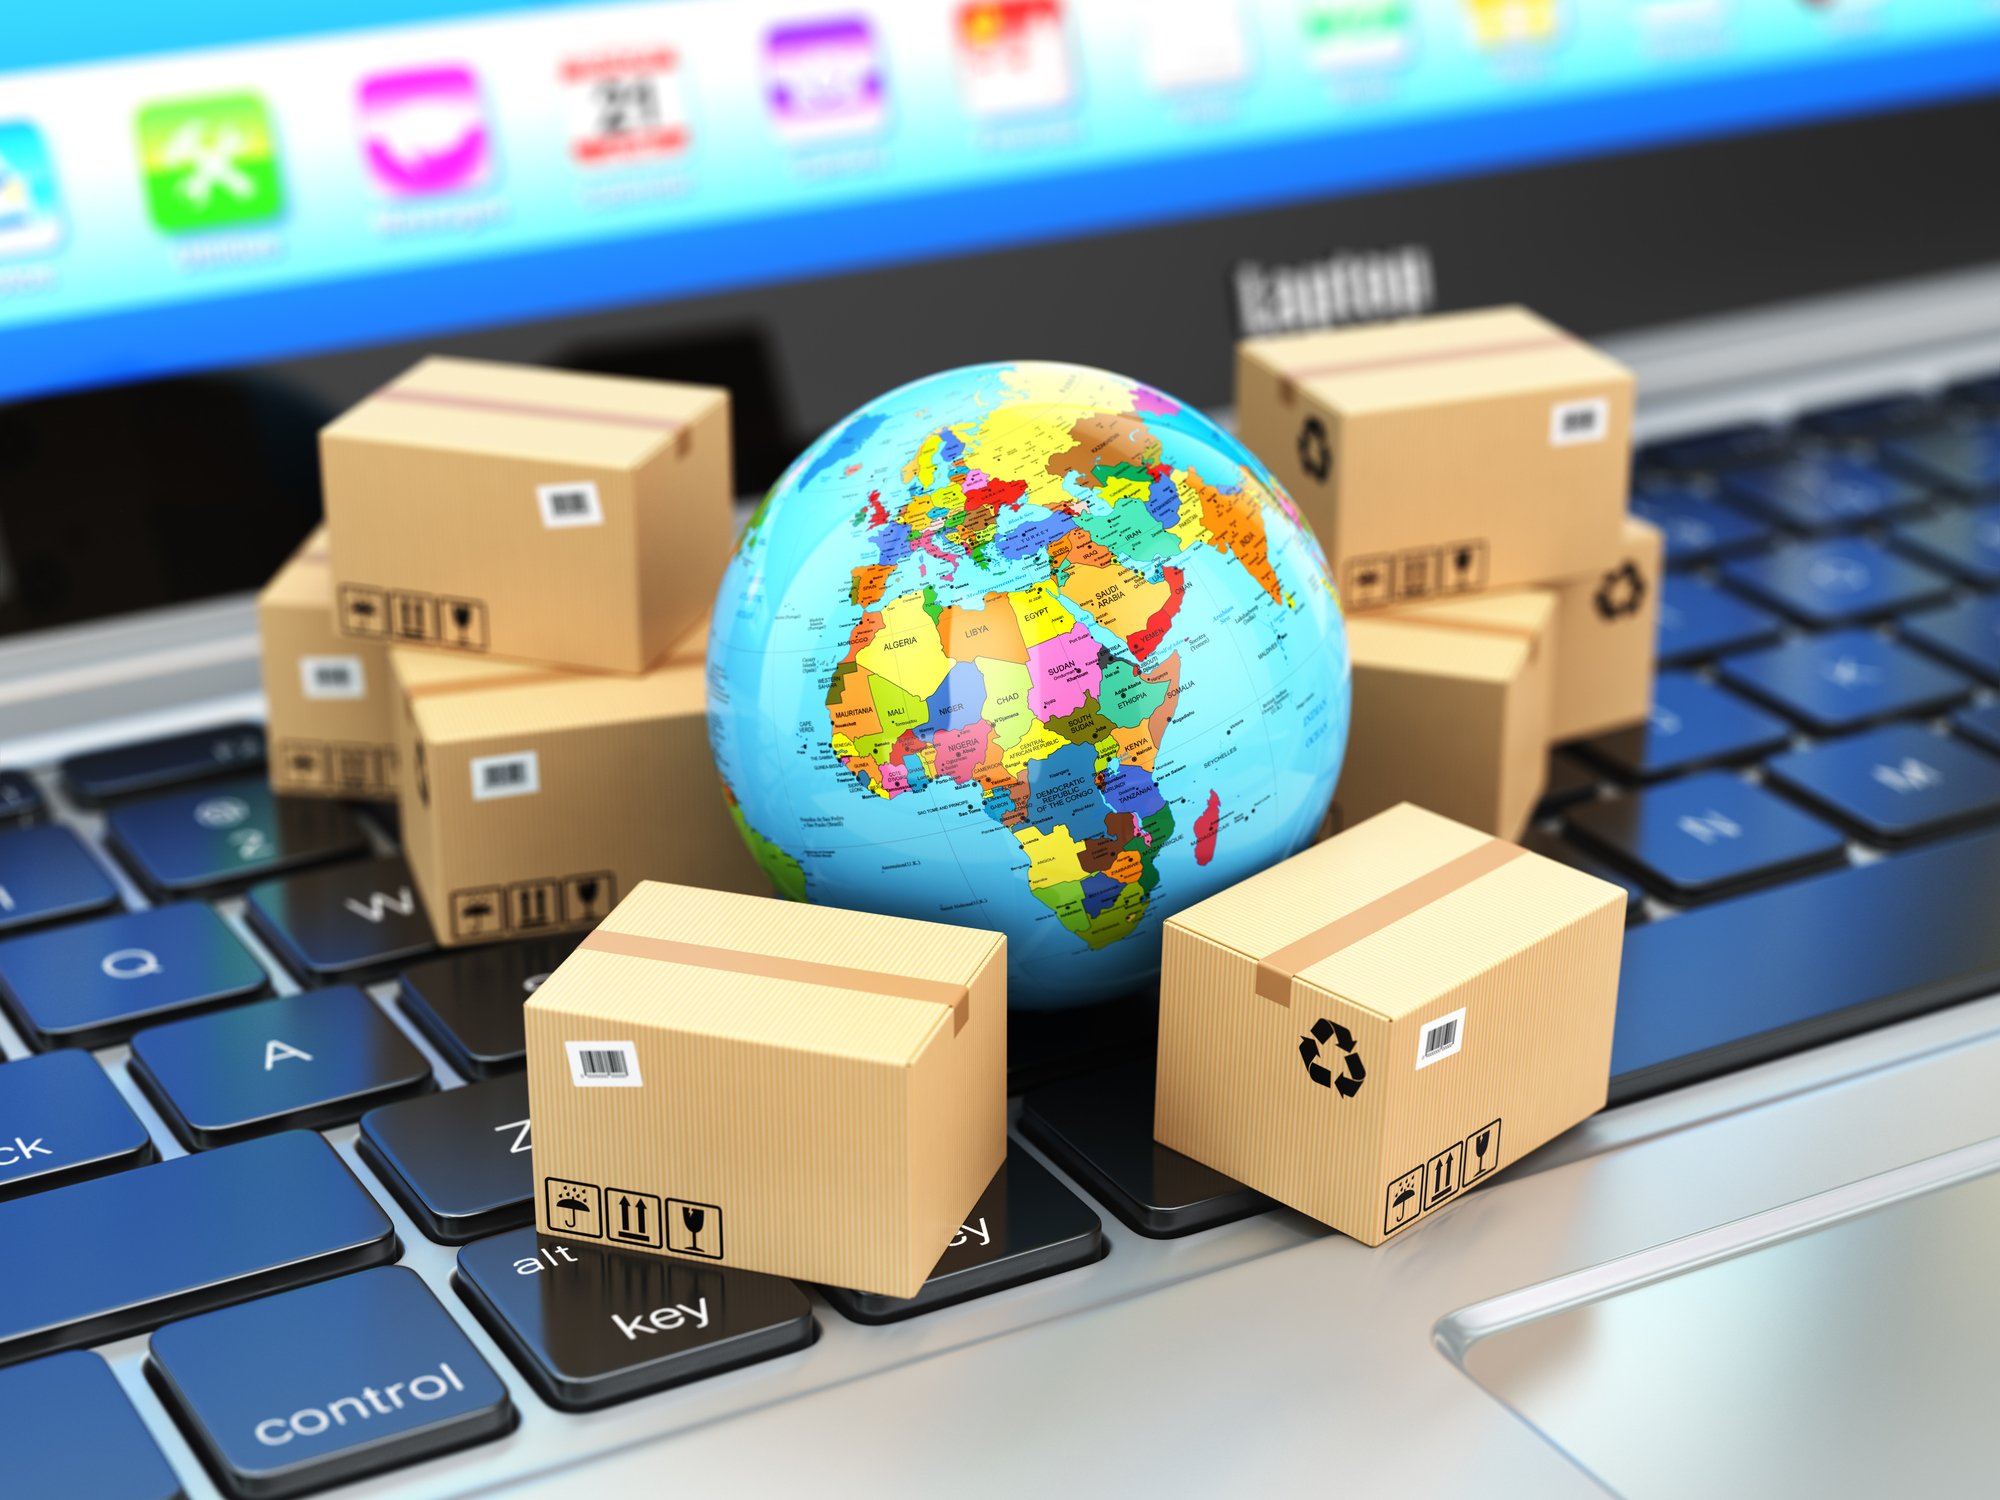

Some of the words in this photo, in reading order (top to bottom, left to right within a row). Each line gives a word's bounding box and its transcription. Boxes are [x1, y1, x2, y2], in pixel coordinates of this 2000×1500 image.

[1179, 514, 1198, 529] PAKISTAN
[1125, 529, 1142, 541] IRAN
[1083, 550, 1098, 560] IRAQ
[966, 579, 1014, 598] Mediterranean
[1096, 585, 1119, 600] SAUDI
[1175, 582, 1192, 594] OMAN
[1098, 591, 1125, 608] ARABIA
[1024, 607, 1049, 622] EGYPT
[965, 625, 989, 638] LIBYA
[1140, 627, 1164, 643] YEMEN
[838, 637, 868, 647] MOROCCO
[884, 637, 917, 651] ALGERIA
[1190, 637, 1209, 652] (Yemen)
[1048, 660, 1075, 676] SUDAN
[1114, 687, 1127, 696] Addis
[1167, 681, 1195, 698] SOMALIA
[996, 692, 1019, 705] CHAD
[1118, 692, 1147, 709] ETHIOPIA
[836, 706, 873, 718] MAURITANIA
[888, 708, 904, 716] MALI
[939, 704, 964, 716] NIGER
[1068, 713, 1092, 727] SOUTH
[1071, 720, 1094, 734] SUDAN
[948, 738, 979, 752] NIGERIA
[1009, 748, 1032, 759] AFRICAN
[1033, 738, 1059, 752] REPUBLIC
[1020, 739, 1045, 750] CENTRAL
[1124, 738, 1148, 752] KENYA
[1136, 746, 1152, 756] Nairobi
[1204, 746, 1237, 769] SEYCHELLES
[1170, 765, 1186, 775] Salaam
[1036, 777, 1085, 799] DEMOCRATIC
[1042, 786, 1080, 804] REPUBLIC
[1048, 799, 1064, 809] THE
[1065, 788, 1093, 806] CONGO
[1037, 857, 1055, 865] ANGOLA
[345, 886, 416, 924] W
[102, 948, 163, 981] Q
[264, 1039, 314, 1072] A
[513, 1245, 579, 1276] alt
[611, 1297, 709, 1341] key
[254, 1362, 465, 1447] control
